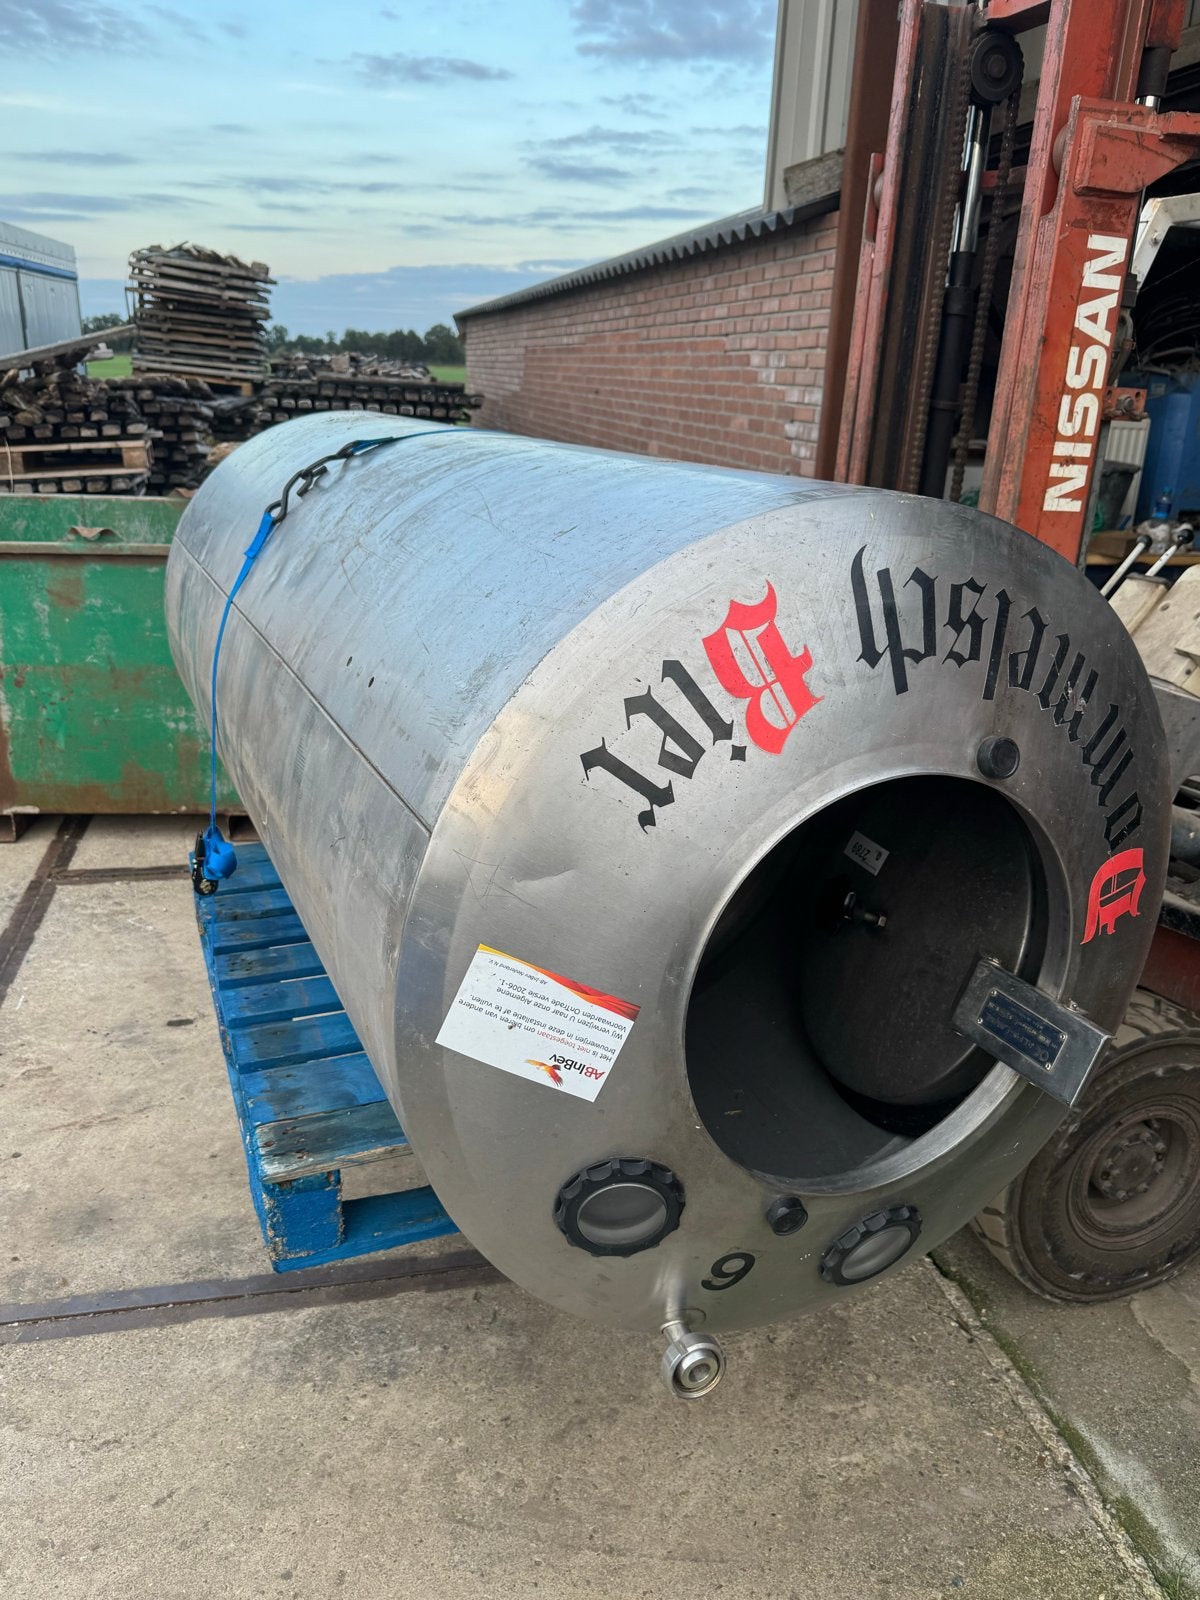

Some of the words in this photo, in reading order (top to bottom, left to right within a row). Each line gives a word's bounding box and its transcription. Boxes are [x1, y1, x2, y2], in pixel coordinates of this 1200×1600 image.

[1043, 234, 1128, 512] NISSAN
[579, 580, 825, 834] Bier
[850, 544, 1147, 945] Dommelsch
[499, 963, 524, 976] Nederland
[499, 978, 527, 995] 2006-1.
[496, 986, 532, 1005] Algemene
[528, 990, 550, 1002] versie
[458, 998, 484, 1013] andere
[533, 1001, 551, 1011] onze
[551, 998, 581, 1015] OnTrade
[485, 1009, 498, 1019] van
[512, 1011, 547, 1028] installatie
[552, 1008, 568, 1018] naar
[569, 1015, 576, 1023] U
[500, 1015, 523, 1029] bieren
[577, 1019, 610, 1035] verwijzen
[582, 1012, 627, 1033] Voorwaarden
[548, 1025, 565, 1035] deze
[566, 1031, 574, 1039] in
[611, 1031, 623, 1040] Wij
[536, 1030, 576, 1049] toegestaan
[575, 1034, 616, 1055] brouwerijen
[577, 1044, 590, 1054] niet
[600, 1054, 613, 1062] Het
